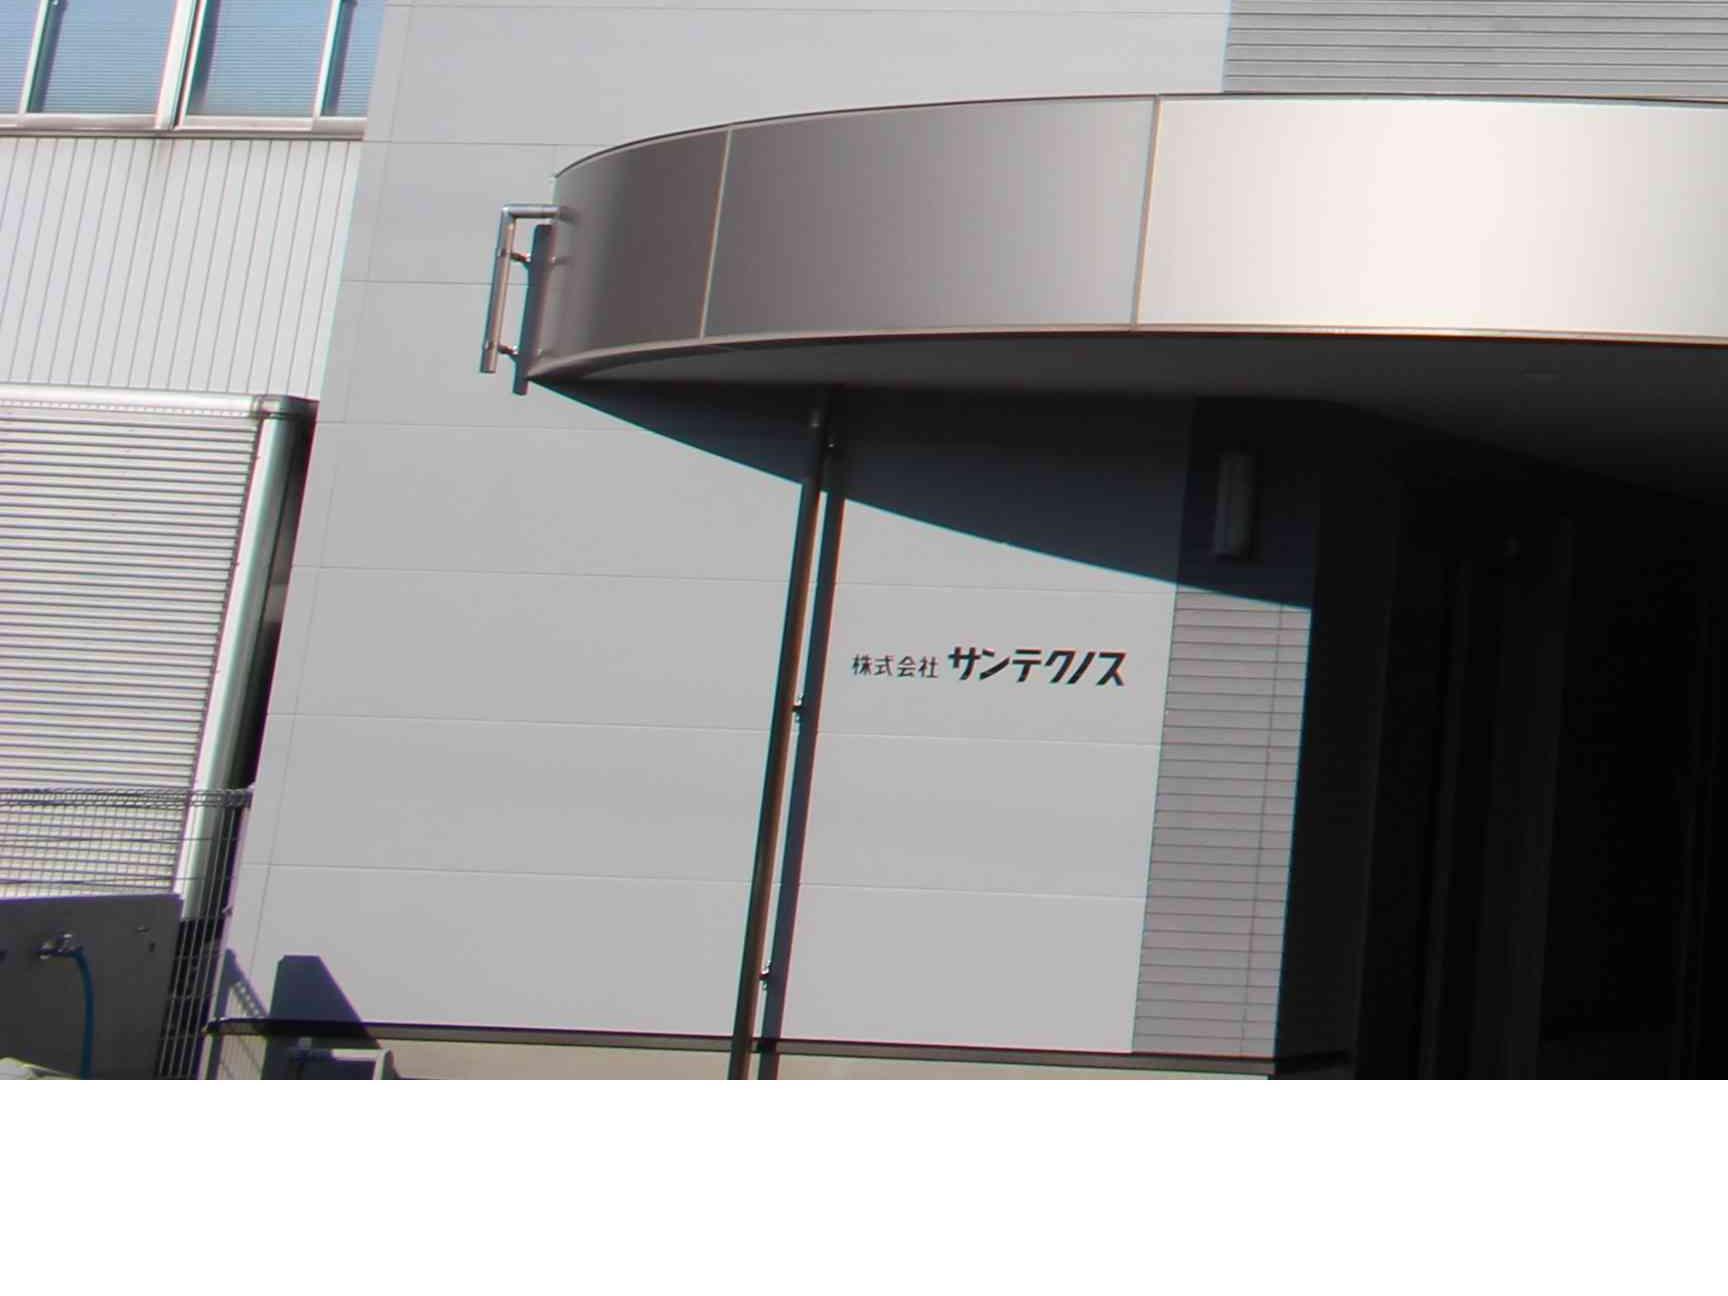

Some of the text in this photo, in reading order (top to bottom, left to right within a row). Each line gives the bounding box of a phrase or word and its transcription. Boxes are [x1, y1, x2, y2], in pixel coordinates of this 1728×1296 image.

[851, 646, 1127, 687] 株式会社 サンテクノス
